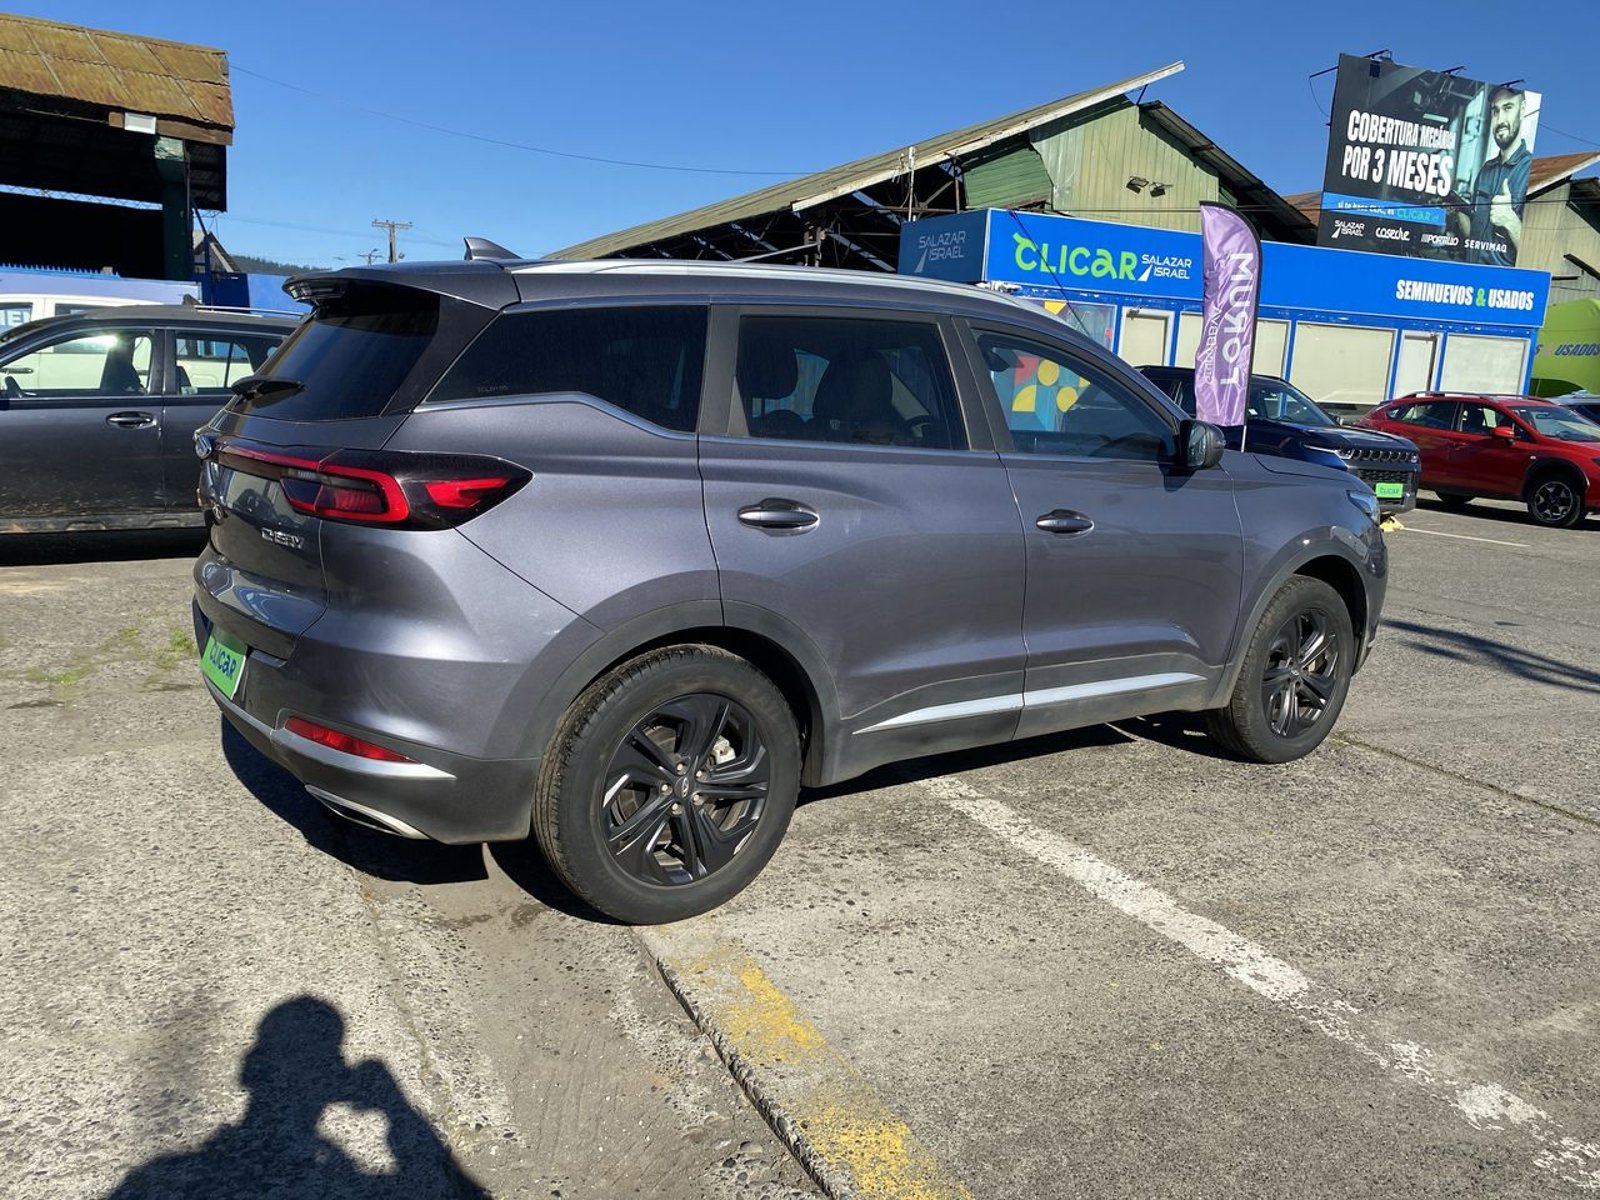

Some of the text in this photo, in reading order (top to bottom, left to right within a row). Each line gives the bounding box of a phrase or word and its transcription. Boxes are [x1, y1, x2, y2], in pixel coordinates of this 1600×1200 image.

[1347, 110, 1419, 147] COBERTURA
[1342, 145, 1454, 197] POR 3 MESES
[1334, 220, 1365, 230] SALAZAR
[919, 230, 966, 249] SALAZAR
[1341, 228, 1364, 237] ISRAEL
[1464, 239, 1507, 253] SERVIMAQ
[929, 247, 965, 261] ISRAEL
[1141, 254, 1192, 269] SALAZAR
[1154, 266, 1190, 280] ISRAEL
[1396, 279, 1534, 311] SEMINUEVOS & USADOS
